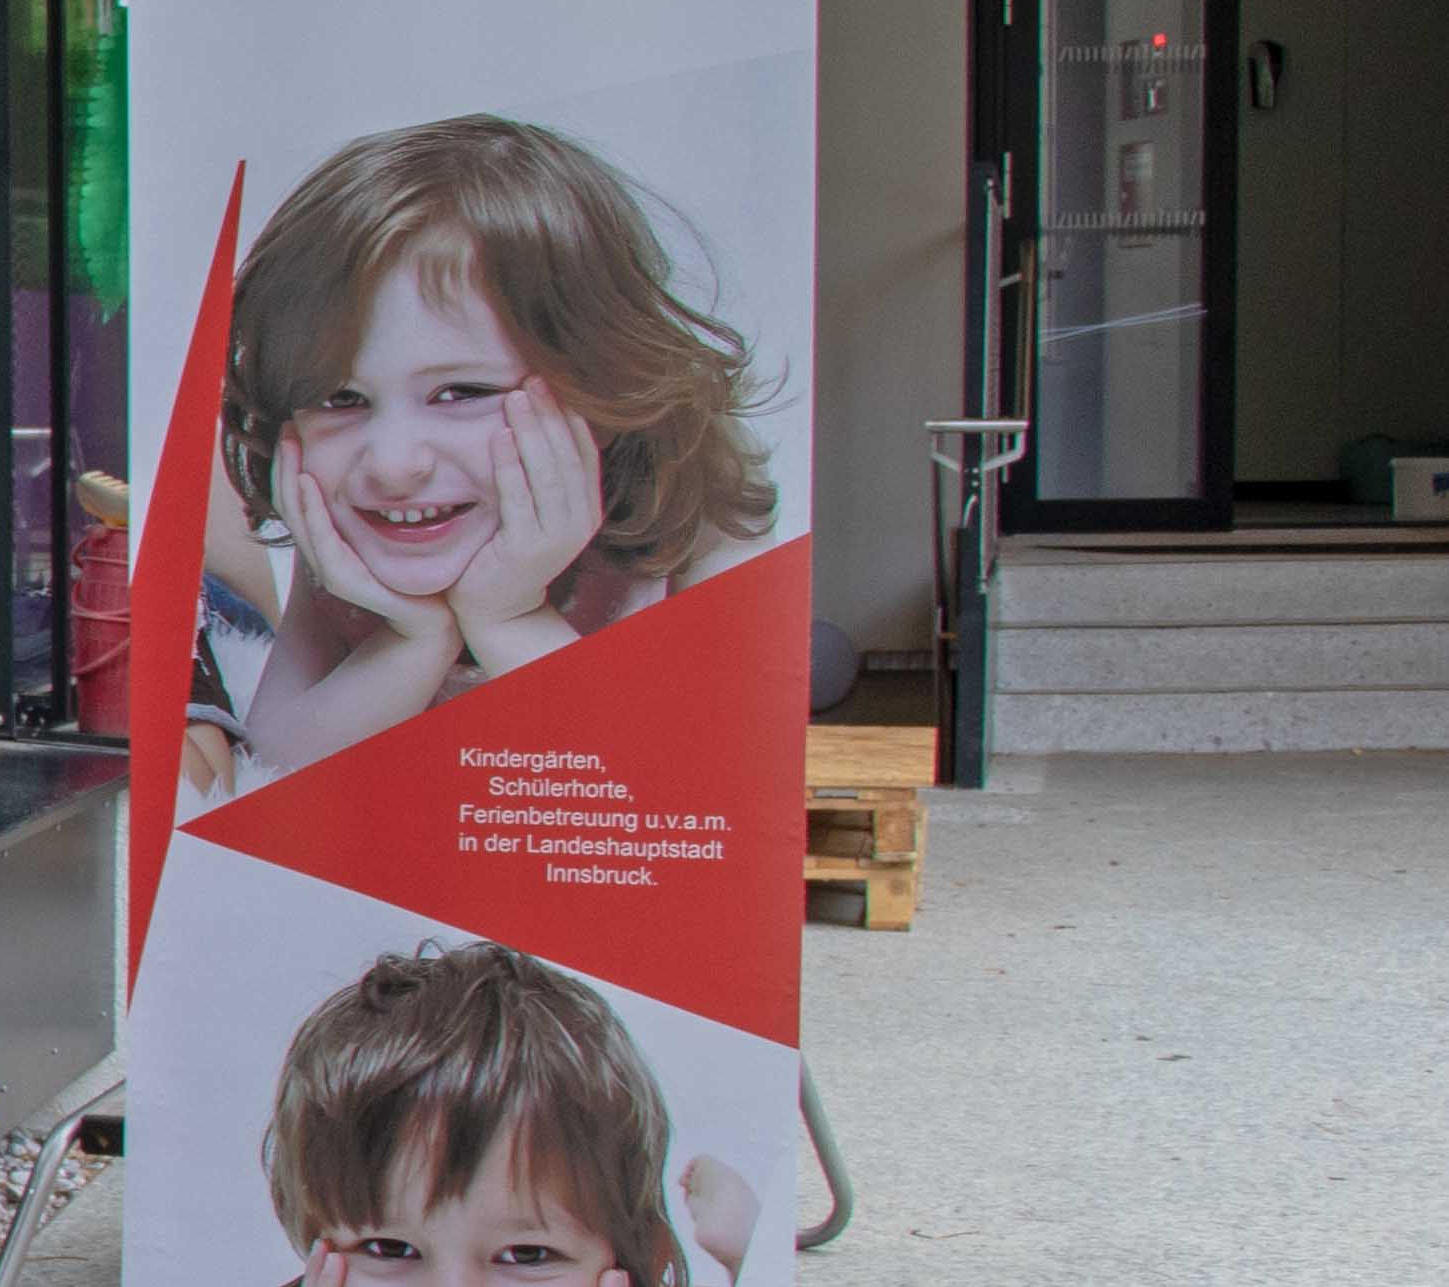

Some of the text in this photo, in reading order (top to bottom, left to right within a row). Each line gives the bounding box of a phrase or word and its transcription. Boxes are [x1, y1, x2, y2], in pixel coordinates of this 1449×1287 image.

[460, 748, 606, 773] Kindergärten,
[488, 776, 635, 802] Schülerhorte,
[459, 804, 732, 831] Ferienbetreuung u.v.a.m.
[458, 833, 724, 860] in der Landeshauptstadt
[546, 863, 658, 886] Innsbruck.
